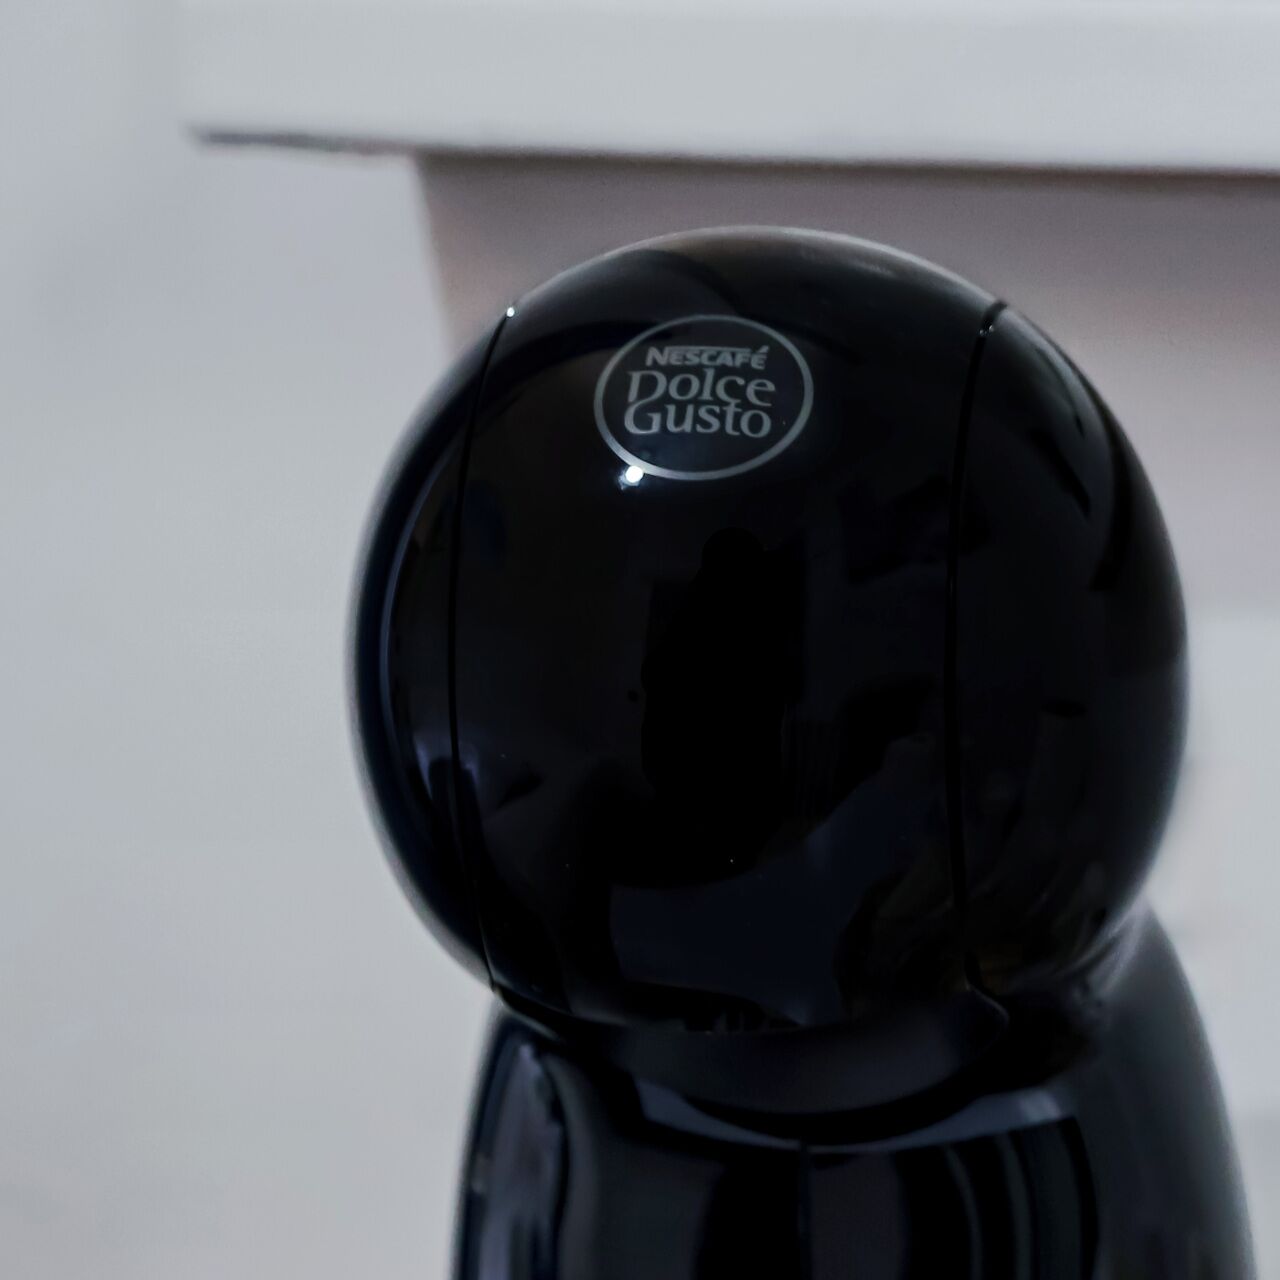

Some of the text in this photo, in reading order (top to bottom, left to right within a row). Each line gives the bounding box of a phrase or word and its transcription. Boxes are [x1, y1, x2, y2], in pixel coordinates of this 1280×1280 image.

[645, 345, 769, 370] NESCAFÉ
[627, 367, 775, 407] Dolce
[624, 399, 772, 438] Gusto
